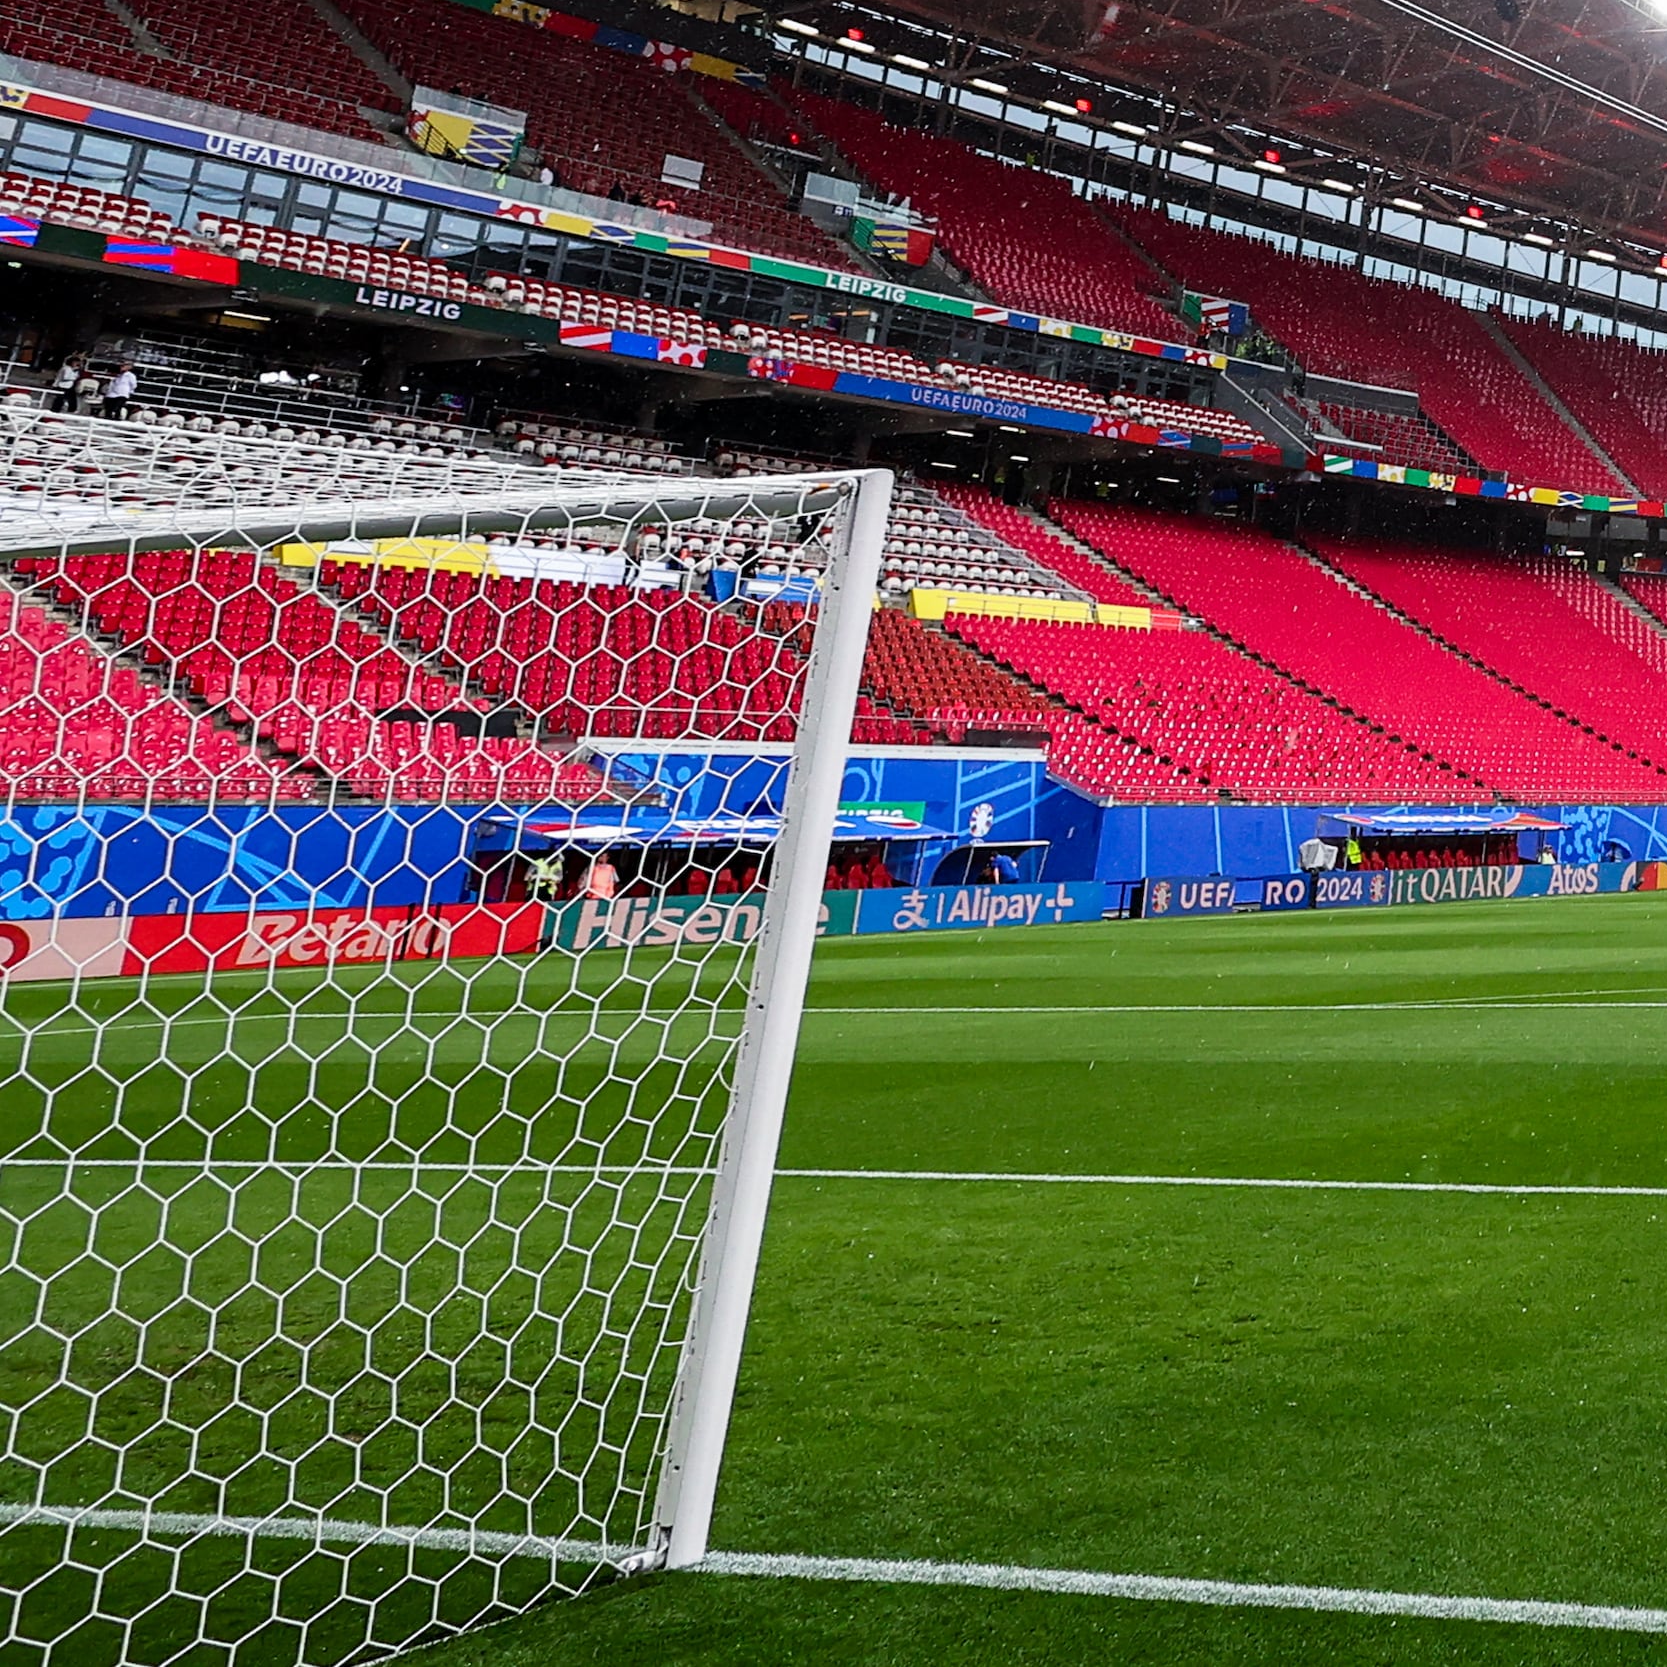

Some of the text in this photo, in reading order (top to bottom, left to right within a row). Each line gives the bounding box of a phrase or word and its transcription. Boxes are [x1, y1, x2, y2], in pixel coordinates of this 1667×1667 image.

[349, 169, 402, 195] 2024
[826, 273, 907, 304] LEIPZIG
[355, 287, 461, 320] LEIPZIG
[995, 403, 1027, 418] 2024
[1316, 877, 1363, 902] 2024
[236, 914, 446, 965] Betano
